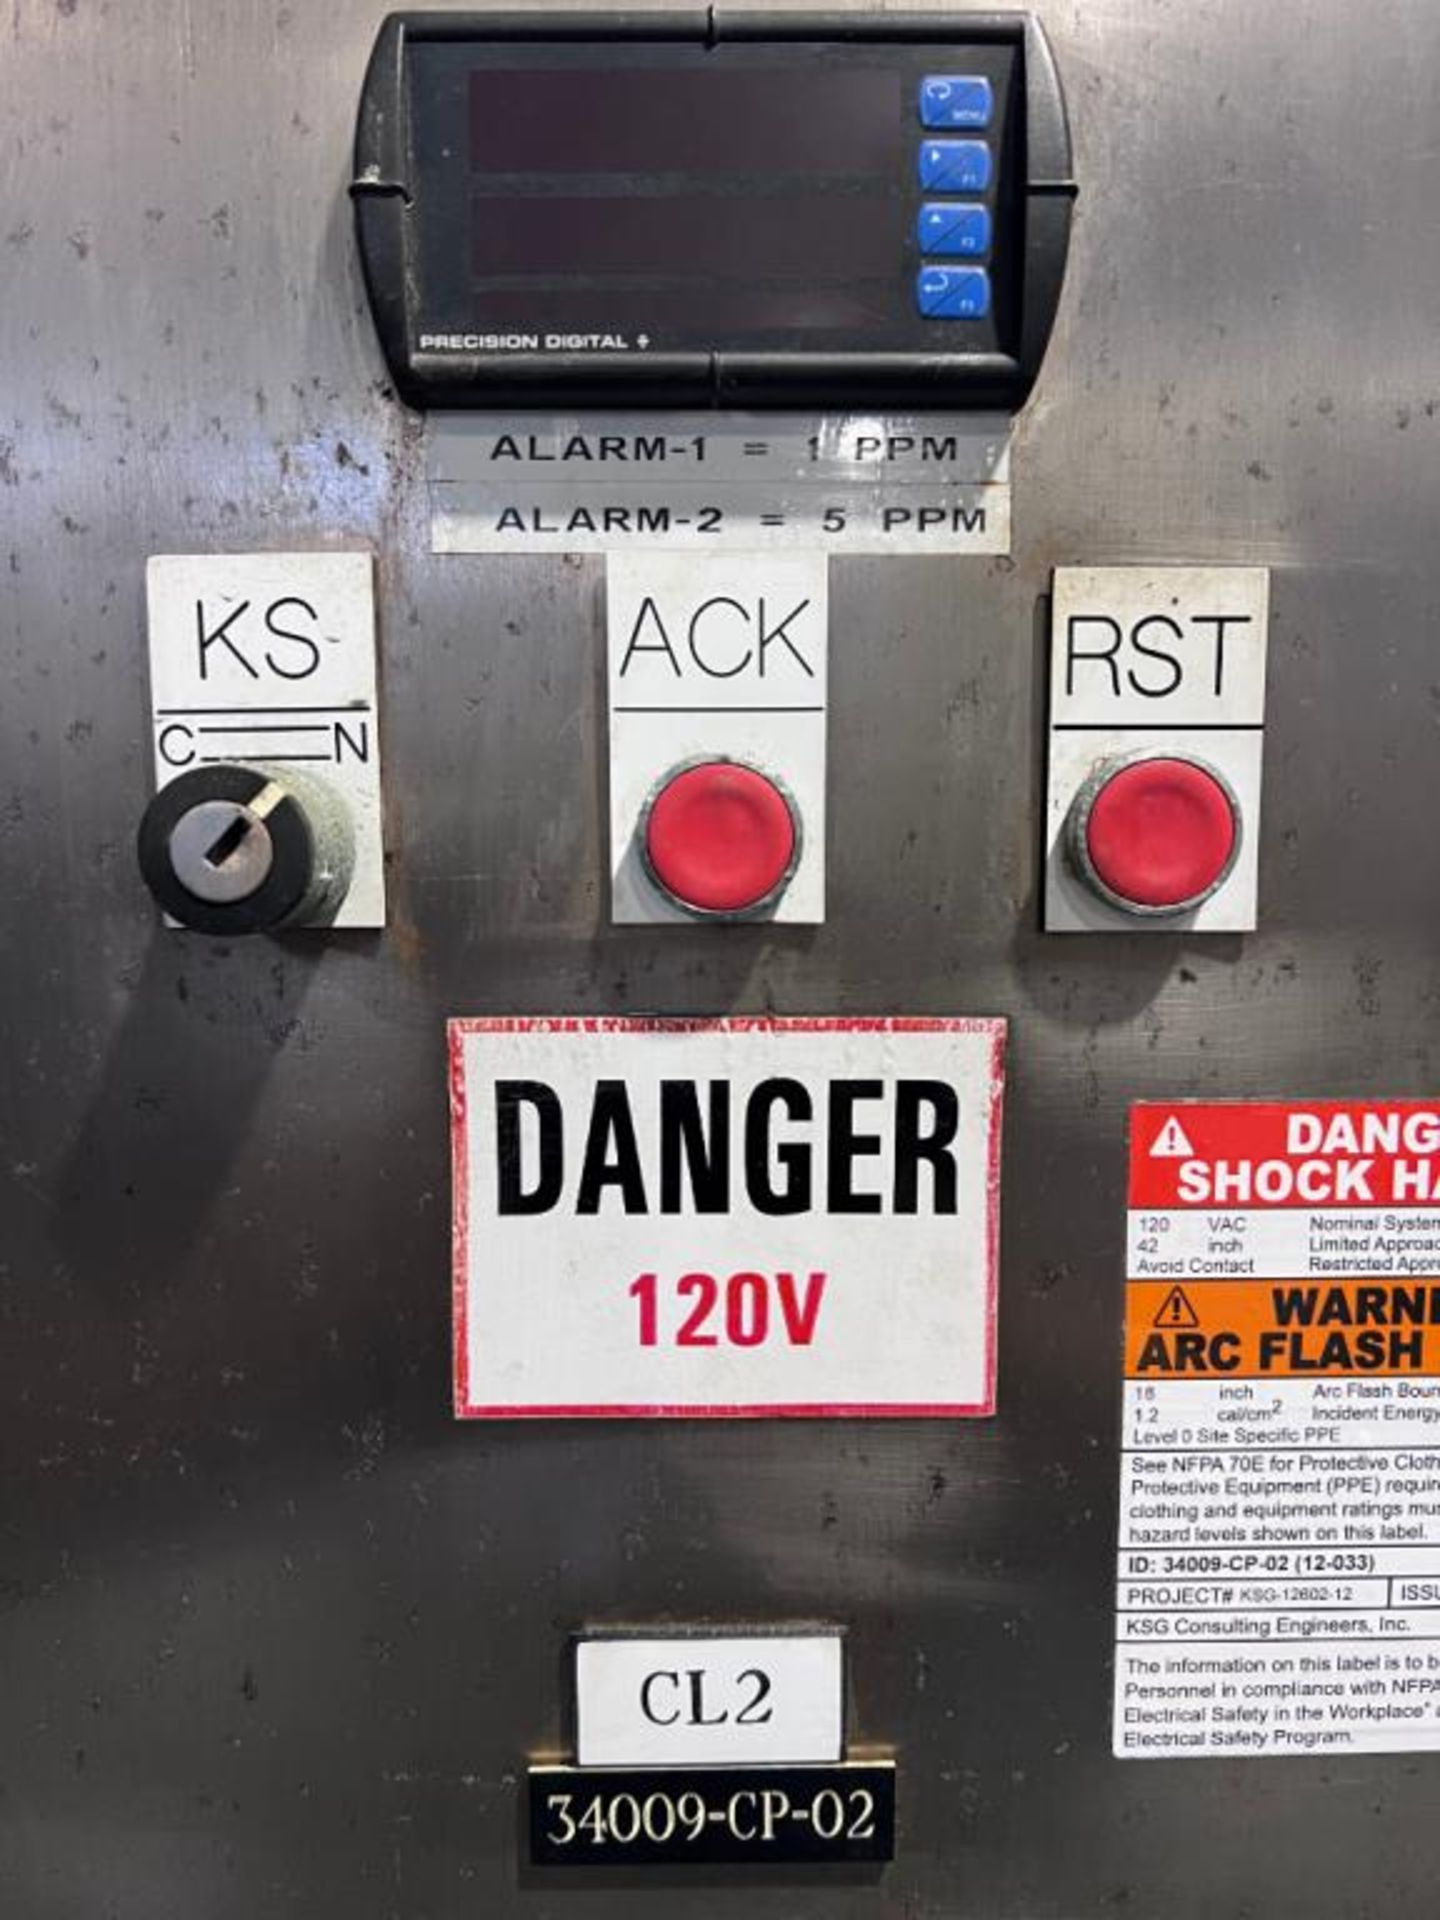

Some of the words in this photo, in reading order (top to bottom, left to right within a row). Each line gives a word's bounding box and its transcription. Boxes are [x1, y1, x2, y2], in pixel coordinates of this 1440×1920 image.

[420, 334, 538, 348] PRECISION
[546, 334, 628, 348] DIGITAL
[490, 435, 706, 460] ALARM-1
[808, 437, 819, 461] 1
[856, 437, 957, 461] PPM
[496, 507, 723, 533] ALARM-2
[822, 508, 846, 532] 5
[883, 508, 986, 532] PPM
[197, 597, 319, 680] KS
[619, 597, 814, 678] ACK
[1066, 615, 1253, 697] RST
[159, 724, 196, 766] C
[333, 722, 368, 763] N
[1288, 1113, 1440, 1154] DANG
[494, 1077, 959, 1217] DANGER
[1177, 1160, 1374, 1201] SHOCK
[1139, 1218, 1170, 1232] 120
[1208, 1218, 1246, 1232] VAC
[1309, 1217, 1379, 1230] Nominal
[1137, 1238, 1158, 1252] 42
[1209, 1238, 1243, 1252] inch
[1309, 1237, 1369, 1251] Limited
[1137, 1259, 1184, 1273] Avoid
[1189, 1258, 1254, 1273] Contact
[1309, 1256, 1393, 1271] Restricted
[629, 1272, 828, 1347] 120V
[1137, 1332, 1240, 1371] ARC
[1259, 1331, 1424, 1370] FLASH
[1219, 1385, 1253, 1399] inch
[1312, 1384, 1340, 1398] Arc
[1347, 1383, 1393, 1398] Flash
[1135, 1408, 1158, 1423] 1.2
[1313, 1406, 1378, 1421] Incident
[1134, 1429, 1177, 1443] Level
[1199, 1429, 1229, 1442] Site
[1235, 1427, 1299, 1446] Specific
[1304, 1427, 1341, 1442] PPE
[1131, 1458, 1166, 1473] See
[1172, 1457, 1224, 1472] NFPA
[1229, 1456, 1263, 1471] 70E
[1269, 1455, 1293, 1471] for
[1299, 1455, 1388, 1470] Protective
[1131, 1480, 1218, 1495] Protective
[1225, 1478, 1321, 1498] Equipment
[1326, 1477, 1380, 1496] (PPE)
[1129, 1503, 1198, 1522] clothing
[1204, 1502, 1237, 1517] and
[1242, 1502, 1336, 1521] equipment
[1342, 1501, 1402, 1520] ratings
[1129, 1527, 1190, 1542] hazard
[1196, 1526, 1246, 1542] levels
[1252, 1525, 1310, 1540] shown
[1316, 1526, 1337, 1540] on
[1344, 1524, 1375, 1539] this
[1380, 1523, 1428, 1539] label.
[1129, 1558, 1156, 1573] ID:
[1164, 1555, 1289, 1572] 34009-CP-02
[1294, 1554, 1375, 1573] (12-033)
[1128, 1588, 1233, 1604] PROJECT#
[1127, 1619, 1169, 1634] KSG
[1174, 1618, 1271, 1637] Consulting
[1276, 1616, 1373, 1636] Engineers,
[1379, 1617, 1411, 1631] Inc.
[1128, 1659, 1160, 1673] The
[1165, 1656, 1266, 1672] information
[1272, 1659, 1293, 1672] on
[1299, 1655, 1332, 1671] this
[1336, 1654, 1380, 1671] label
[1384, 1655, 1400, 1670] is
[1405, 1655, 1421, 1669] to
[641, 1669, 773, 1726] CL2
[1124, 1681, 1216, 1697] Personnel
[1221, 1681, 1237, 1697] in
[1242, 1680, 1344, 1700] compliance
[1351, 1679, 1386, 1694] with
[1124, 1707, 1206, 1723] Electrical
[1212, 1706, 1268, 1724] Safety
[1274, 1706, 1290, 1721] in
[1295, 1705, 1323, 1720] the
[1124, 1731, 1205, 1747] Electrical
[1210, 1730, 1268, 1749] Safety
[1274, 1729, 1354, 1748] Program.
[547, 1789, 875, 1845] 34009-CP-02
